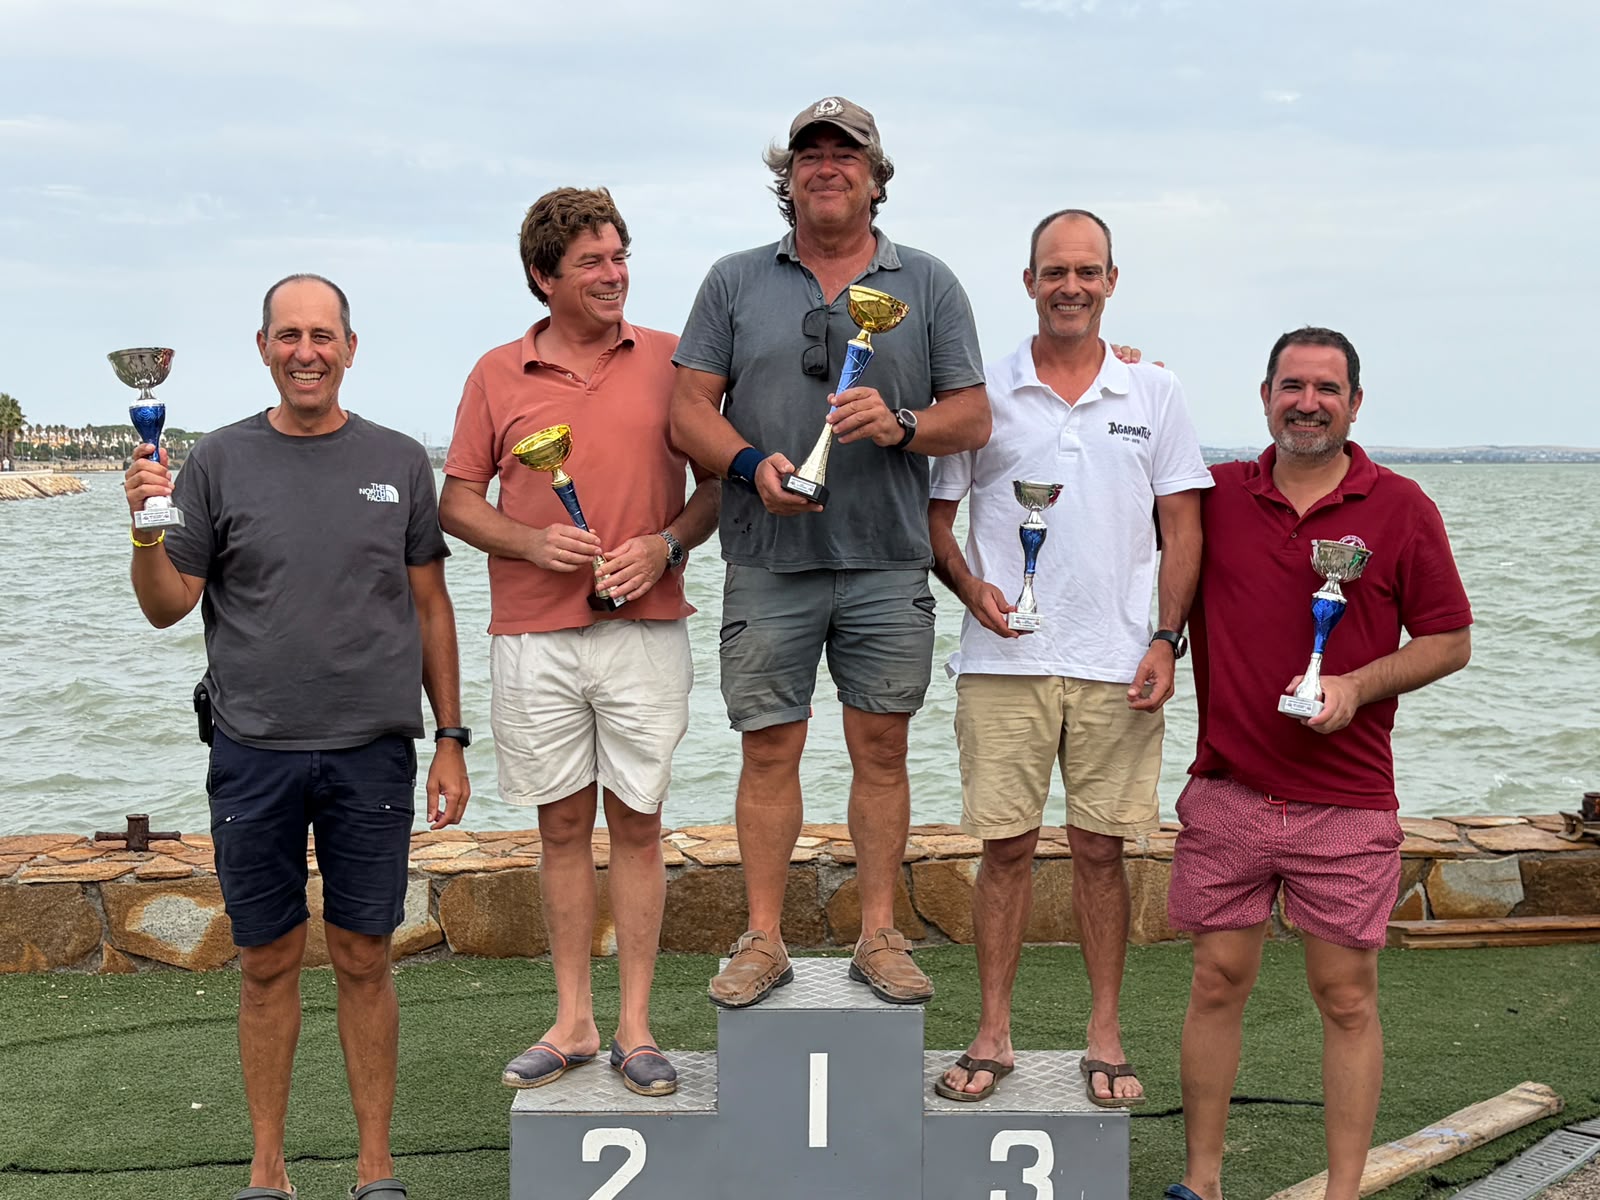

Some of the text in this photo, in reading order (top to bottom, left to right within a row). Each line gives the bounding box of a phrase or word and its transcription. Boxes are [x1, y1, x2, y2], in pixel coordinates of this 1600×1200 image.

[370, 482, 387, 490] THE
[359, 488, 387, 497] NORTH
[366, 494, 387, 502] FACE
[582, 1128, 647, 1200] 2
[990, 1130, 1054, 1200] 3
